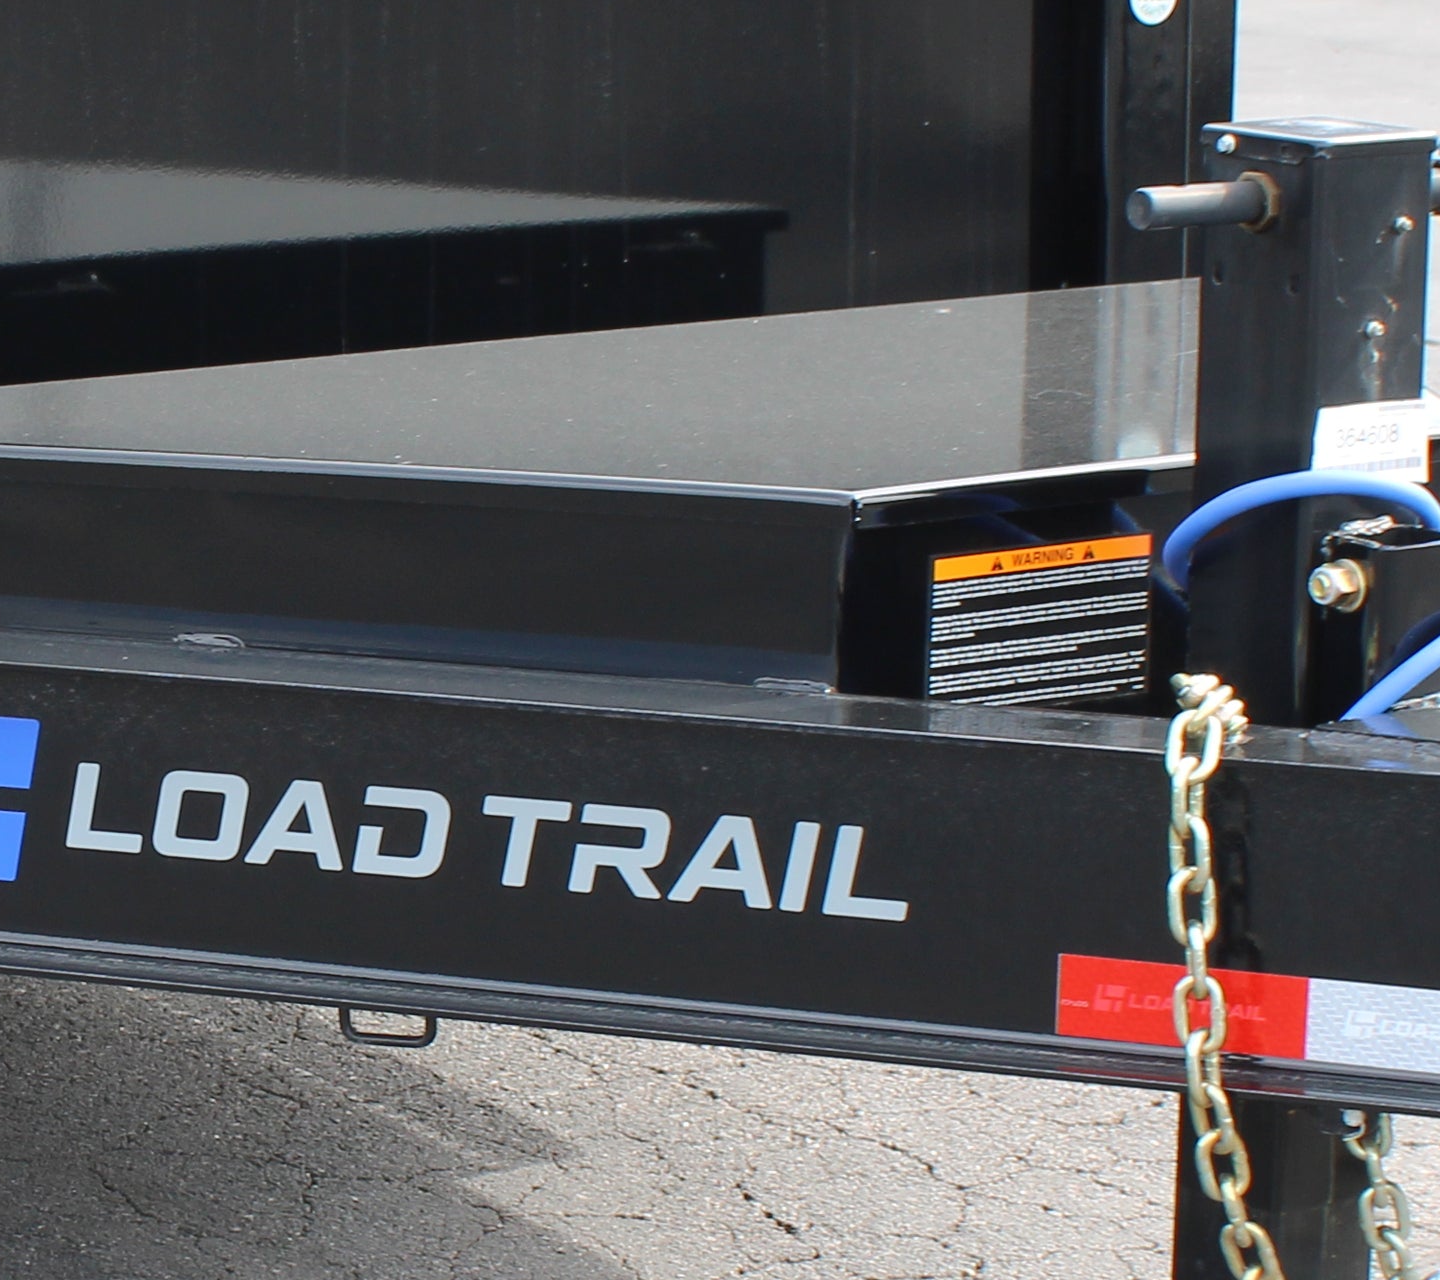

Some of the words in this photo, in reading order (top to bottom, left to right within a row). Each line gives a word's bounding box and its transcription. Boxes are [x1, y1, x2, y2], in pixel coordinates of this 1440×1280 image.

[1335, 422, 1401, 449] 364608
[1010, 547, 1075, 567] WARNING
[65, 761, 451, 880] LOAD
[481, 794, 910, 923] TRAIL
